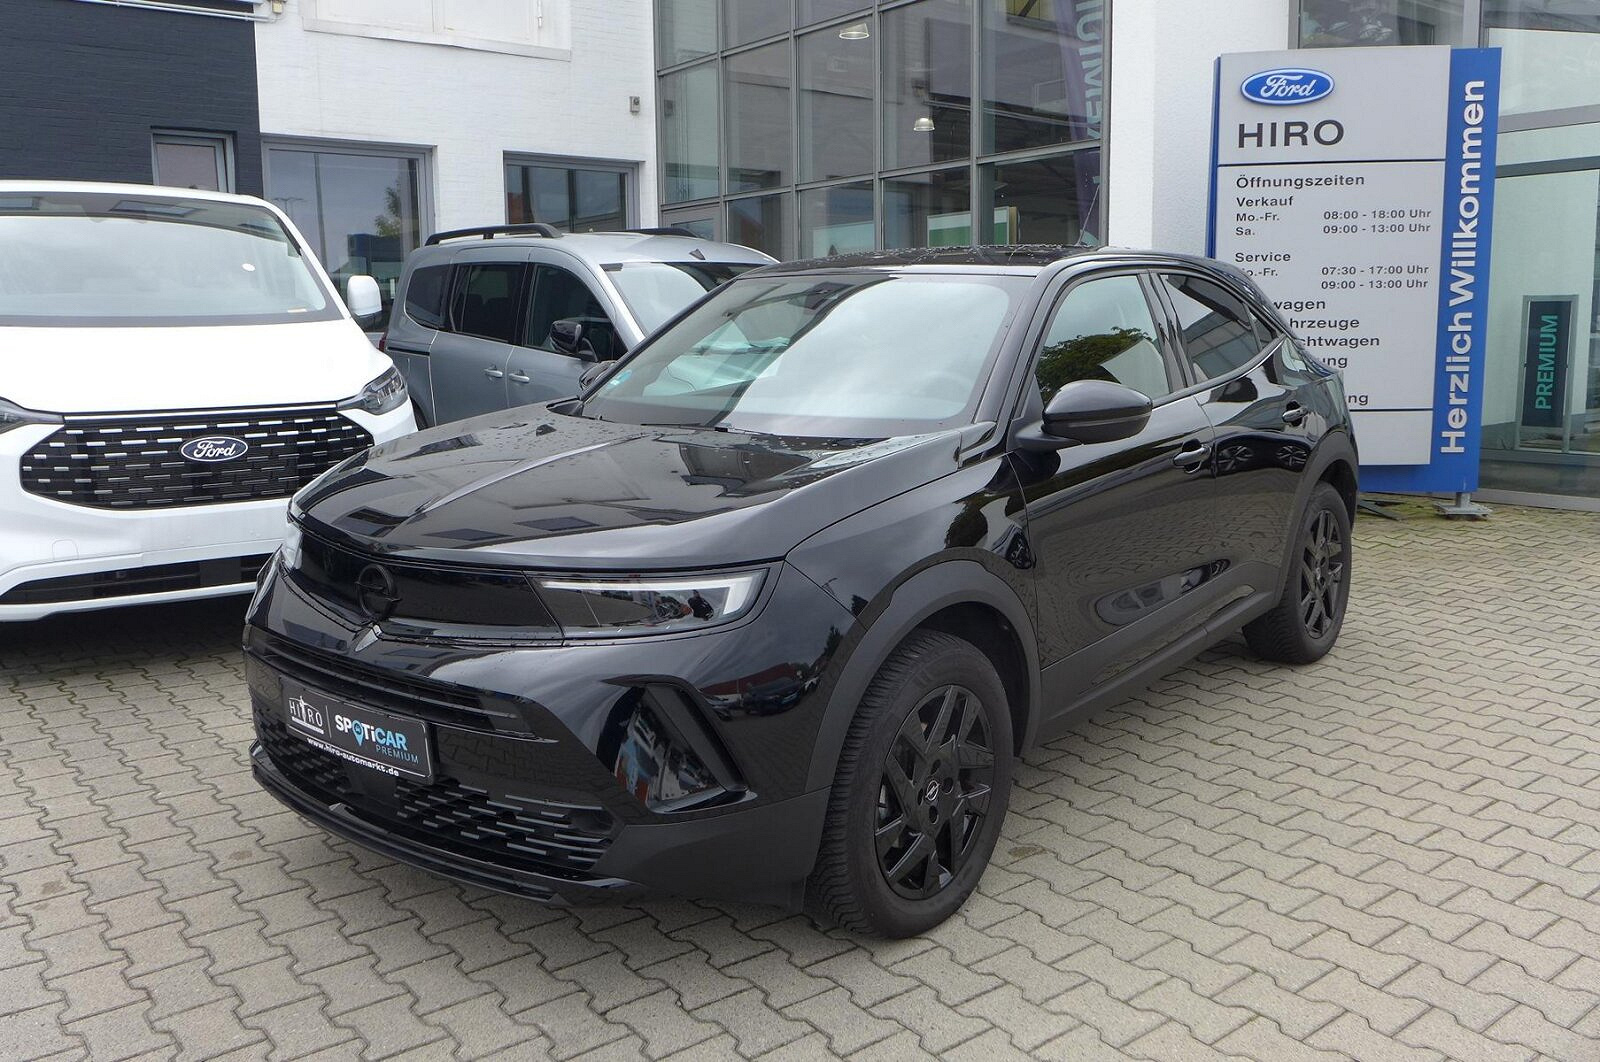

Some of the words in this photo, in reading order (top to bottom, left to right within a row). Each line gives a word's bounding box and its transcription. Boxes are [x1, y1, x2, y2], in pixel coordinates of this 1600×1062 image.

[1259, 74, 1316, 98] Ford
[1238, 119, 1345, 149] HIRO
[1236, 174, 1365, 191] Öffnungszeiten
[1449, 80, 1485, 307] Willkommen
[1236, 195, 1294, 208] Verkauf
[1236, 211, 1280, 222] Mo.-Fr.
[1323, 210, 1359, 220] 08:00
[1371, 209, 1405, 219] 18:00
[1409, 208, 1432, 219] Uhr
[1235, 226, 1256, 237] Sa.
[1322, 224, 1359, 235] 09:00
[1370, 223, 1405, 234] 13:00
[1408, 223, 1431, 233] Uhr
[1235, 252, 1291, 263] Service
[1242, 267, 1279, 277] o.-Fr.
[1321, 265, 1358, 276] 07:30
[1369, 264, 1403, 275] 17:00
[1407, 264, 1430, 275] Uhr
[1321, 279, 1357, 290] 09:00
[1368, 278, 1402, 289] 13:00
[1406, 278, 1428, 289] Uhr
[1273, 300, 1326, 312] wagen
[1290, 318, 1360, 331] hrzeuge
[1535, 315, 1558, 409] PREMIUM
[1440, 311, 1473, 453] Herzlich
[193, 440, 236, 458] Ford
[288, 698, 323, 728] HIRO
[307, 737, 400, 777] www.hiro-automarkt.de
[375, 744, 419, 765] PREMIUM
